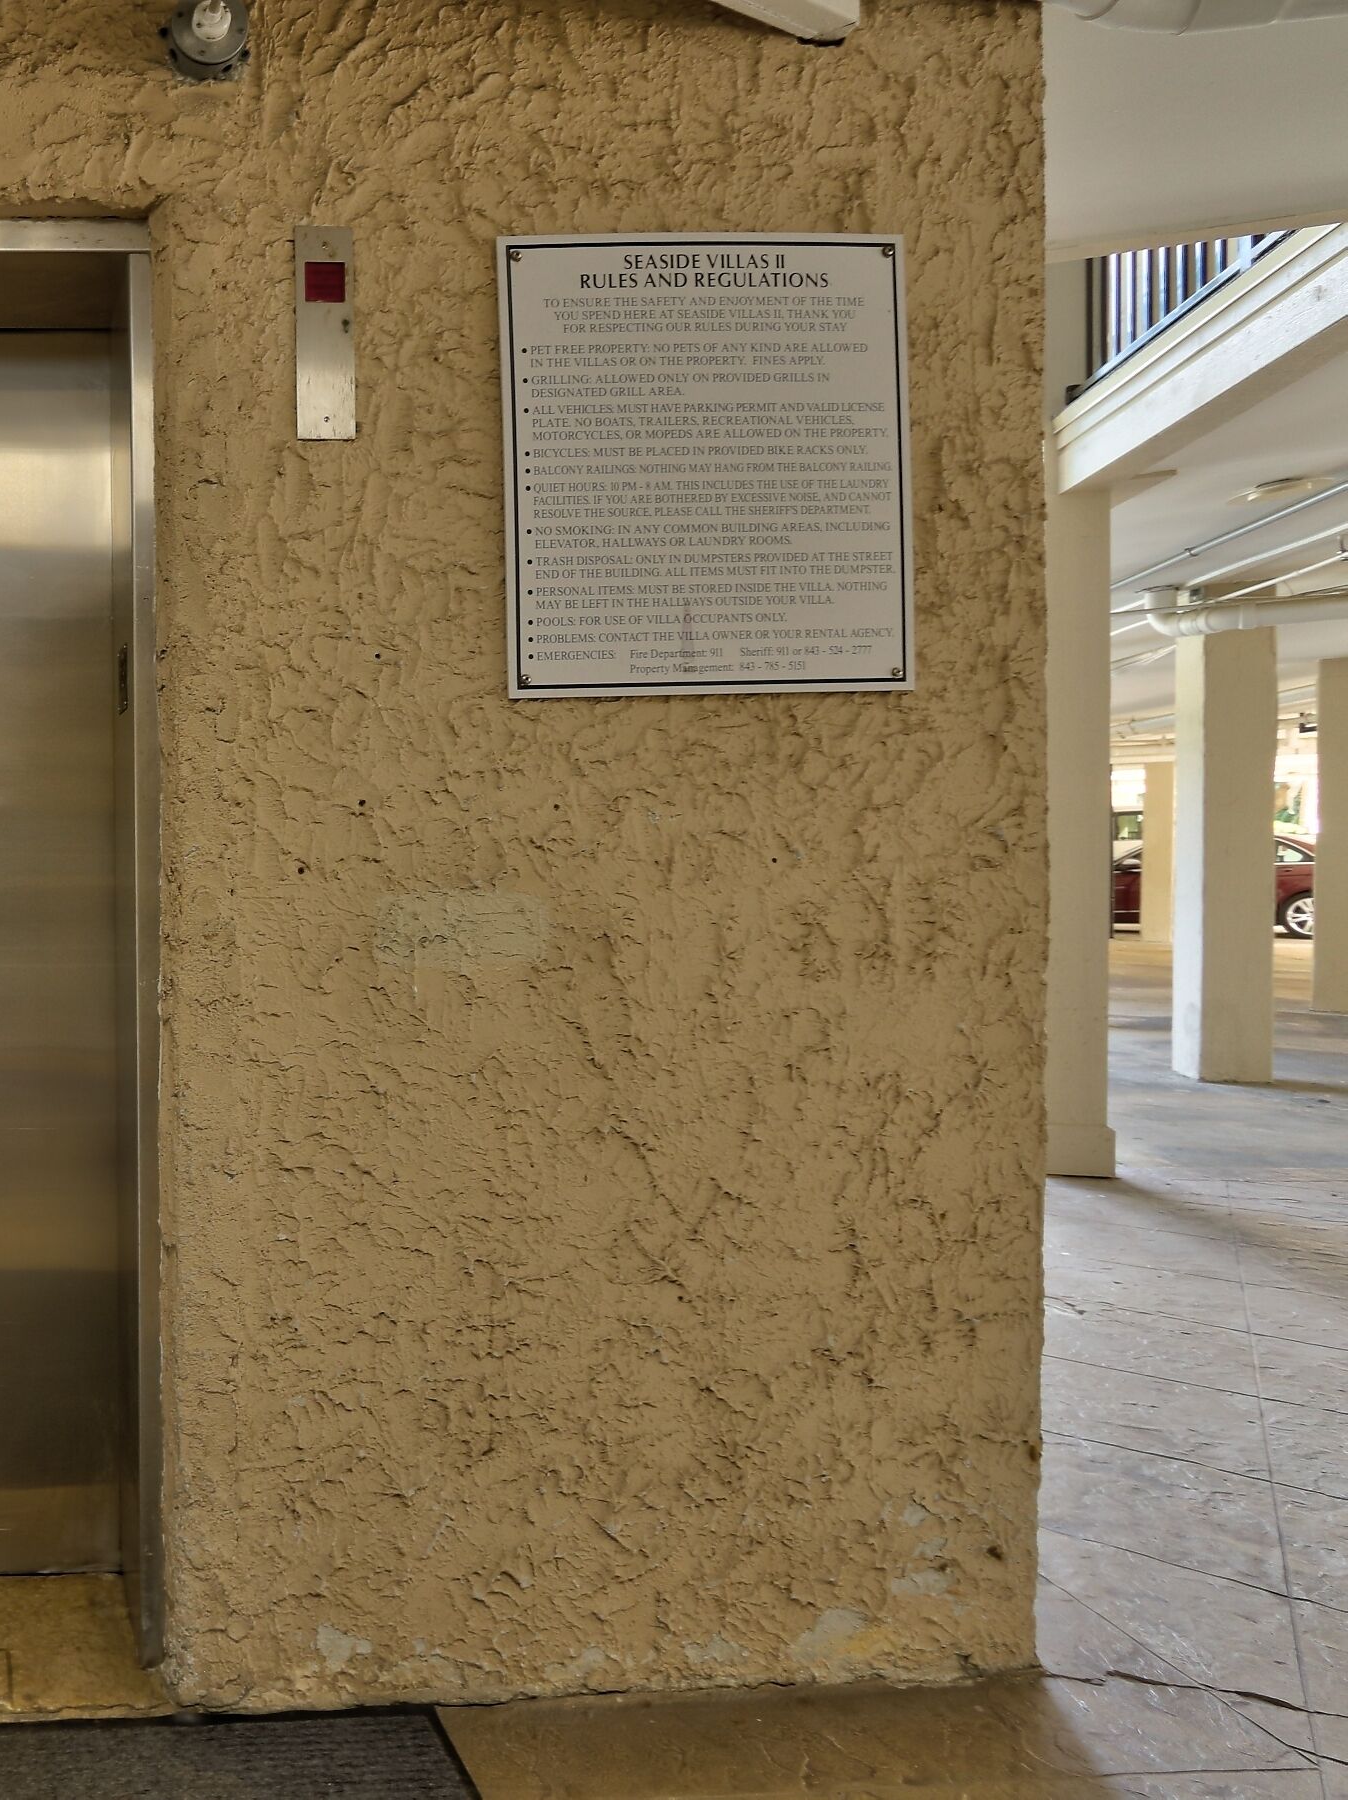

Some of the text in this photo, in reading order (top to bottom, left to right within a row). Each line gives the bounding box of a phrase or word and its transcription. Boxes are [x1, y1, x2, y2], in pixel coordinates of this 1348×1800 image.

[624, 254, 784, 269] SEASIDE VILLAS II
[579, 272, 828, 288] RULES AND REGULATIONS
[544, 296, 864, 308] TO ENSURE THE SAFETY AND ENJOYMENT OF THE TIME
[554, 311, 578, 320] YOU
[582, 310, 621, 320] SPEND
[624, 310, 656, 319] HERE
[660, 309, 674, 319] AT
[677, 309, 725, 318] SEASIDE
[729, 309, 771, 318] VILLAS
[786, 309, 828, 318] THANK
[832, 309, 856, 319] YOU
[563, 322, 847, 333] FOR RESPECTING OUR RULES DURING YOUR STAY
[530, 342, 868, 355] PET FREE PROPERTY: NO PETS OF ANY KIND ARE ALLOWED
[530, 359, 543, 368] IN
[546, 358, 570, 367] THE
[574, 357, 617, 366] VILLAS
[619, 356, 636, 366] OR
[639, 356, 656, 366] ON
[659, 356, 683, 365] THE
[752, 355, 786, 365] FINES
[789, 356, 826, 365] APPLY.
[531, 372, 830, 384] GRILLING: ALLOWED ONLY ON PROVIDED GRILLS IN
[531, 386, 685, 397] DESIGNATED GRILL AREA.
[574, 417, 592, 427] NO
[702, 416, 792, 425] RECREATIONAL
[532, 430, 622, 440] MOTORCYCLES,
[625, 430, 641, 439] OR
[645, 429, 693, 439] MOPEDS
[696, 429, 720, 438] ARE
[724, 428, 782, 438] ALLOWED
[784, 428, 801, 438] ON
[803, 428, 826, 437] THE
[593, 447, 625, 457] MUST
[629, 447, 642, 456] BE
[646, 446, 690, 456] PLACED
[693, 446, 705, 456] IN
[708, 446, 764, 455] PROVIDED
[767, 445, 793, 455] BIKE
[796, 445, 834, 454] RACKS
[535, 526, 552, 536] NO
[555, 525, 614, 535] SMOKING:
[618, 525, 630, 534] IN
[634, 524, 659, 534] ANY
[663, 524, 718, 533] COMMON
[721, 523, 778, 532] BUILDING
[825, 521, 890, 531] INCLUDING
[602, 537, 666, 547] HALLWAYS
[669, 537, 685, 546] OR
[689, 536, 745, 546] LAUNDRY
[535, 551, 893, 566] TRASH DISPOSAL: ONLY IN DUMPSTERS PROVIDED AT THE STREET
[536, 617, 576, 626] POOLS:
[579, 616, 601, 626] FOR
[604, 615, 626, 625] USE
[628, 615, 643, 625] OF
[646, 614, 680, 624] VILLA
[683, 613, 753, 623] OCCUPANTS
[536, 633, 595, 643] PROBLEMS:
[598, 632, 649, 642] CONTACT
[652, 632, 674, 641] THE
[677, 631, 709, 640] VILLA
[712, 630, 752, 640] OWNER
[754, 630, 770, 639] OR
[773, 629, 802, 639] YOUR
[805, 628, 847, 638] RENTAL
[536, 649, 616, 661] EMERGENCIES:
[630, 649, 648, 660] Fire
[710, 648, 723, 658] 911
[630, 664, 670, 676] Property
